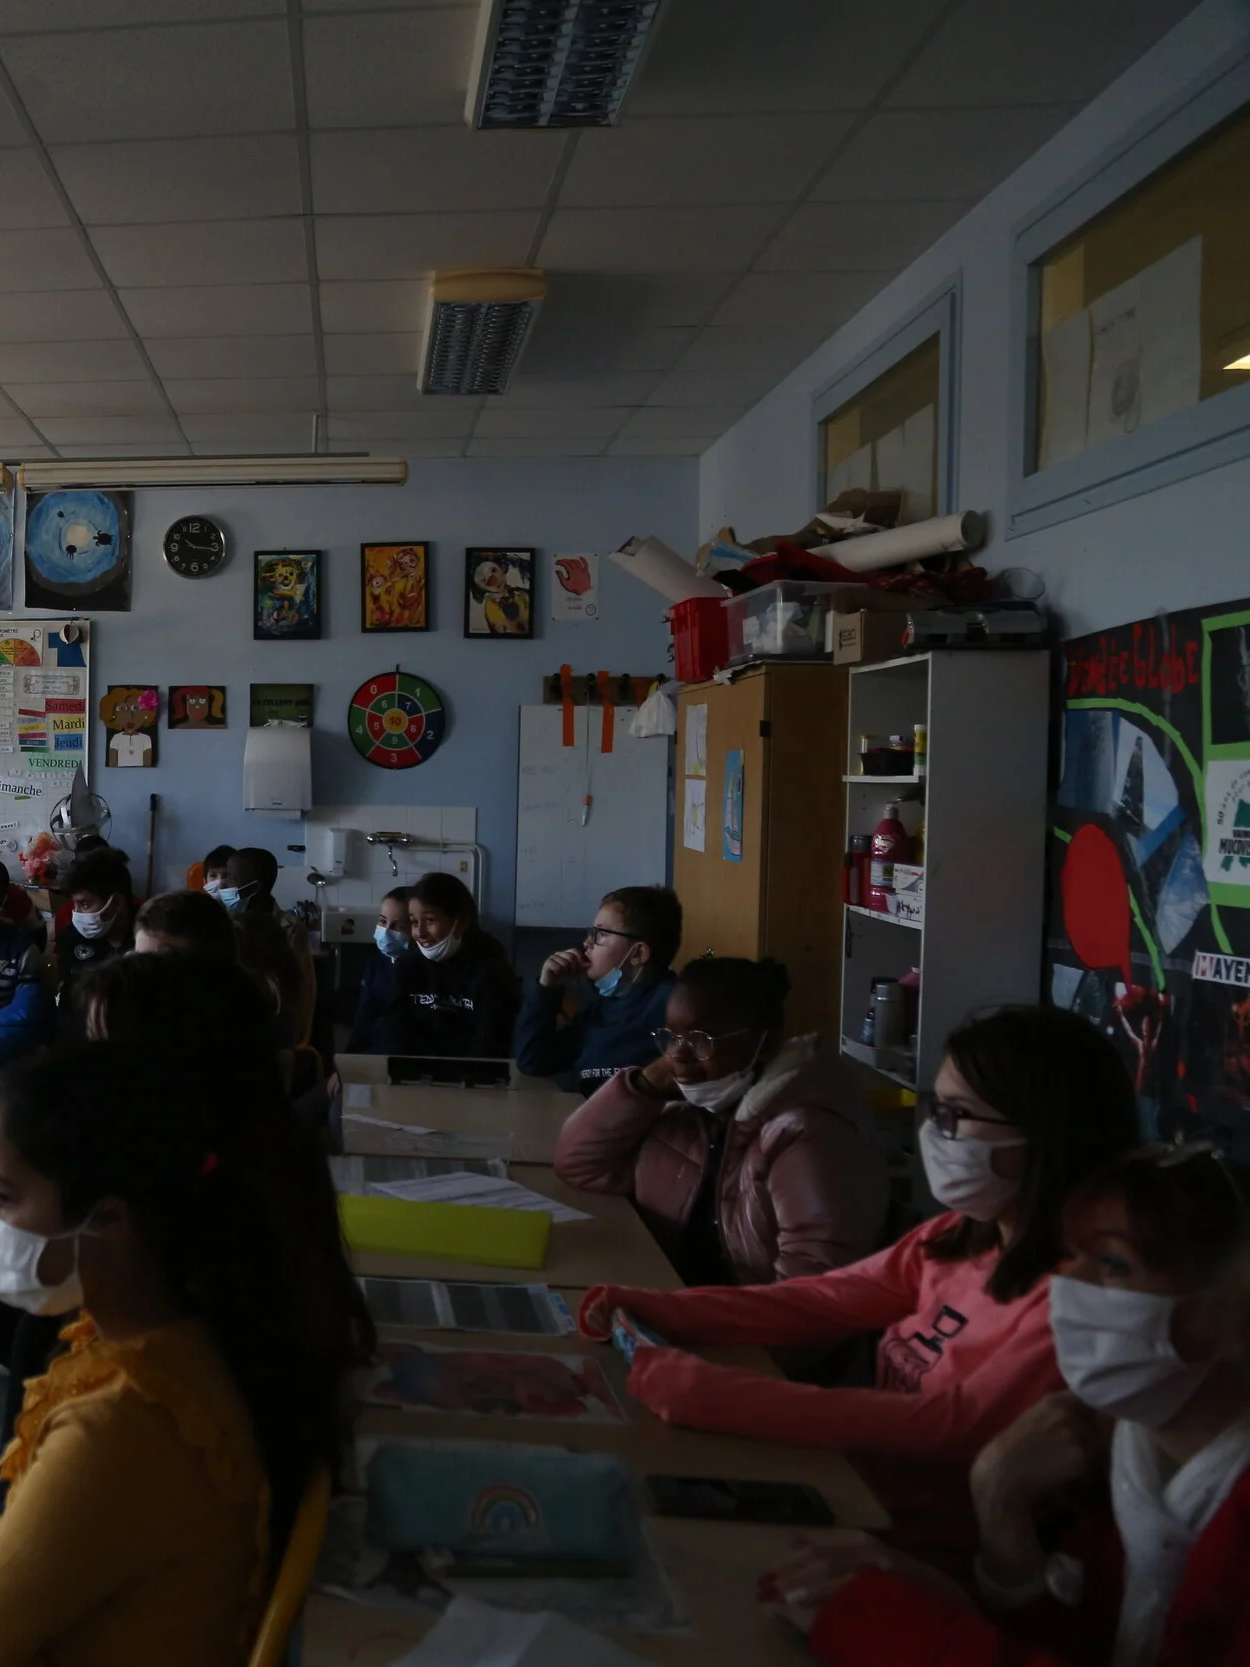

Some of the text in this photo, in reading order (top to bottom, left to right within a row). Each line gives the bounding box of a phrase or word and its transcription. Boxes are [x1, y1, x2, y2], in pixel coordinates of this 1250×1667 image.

[190, 522, 200, 533] 12
[171, 542, 179, 552] 9
[211, 542, 219, 552] 3
[191, 562, 199, 572] 6
[369, 684, 377, 694] 0
[415, 687, 421, 697] 1
[46, 700, 86, 711] Samedi
[381, 700, 388, 708] 6
[405, 702, 412, 710] 7
[53, 717, 85, 730] Mardi
[373, 722, 380, 730] 5
[390, 716, 402, 726] 10
[355, 725, 363, 734] 4
[426, 730, 435, 740] 2
[55, 736, 83, 748] Jeudi
[390, 753, 398, 762] 3
[29, 758, 79, 769] VENDRED
